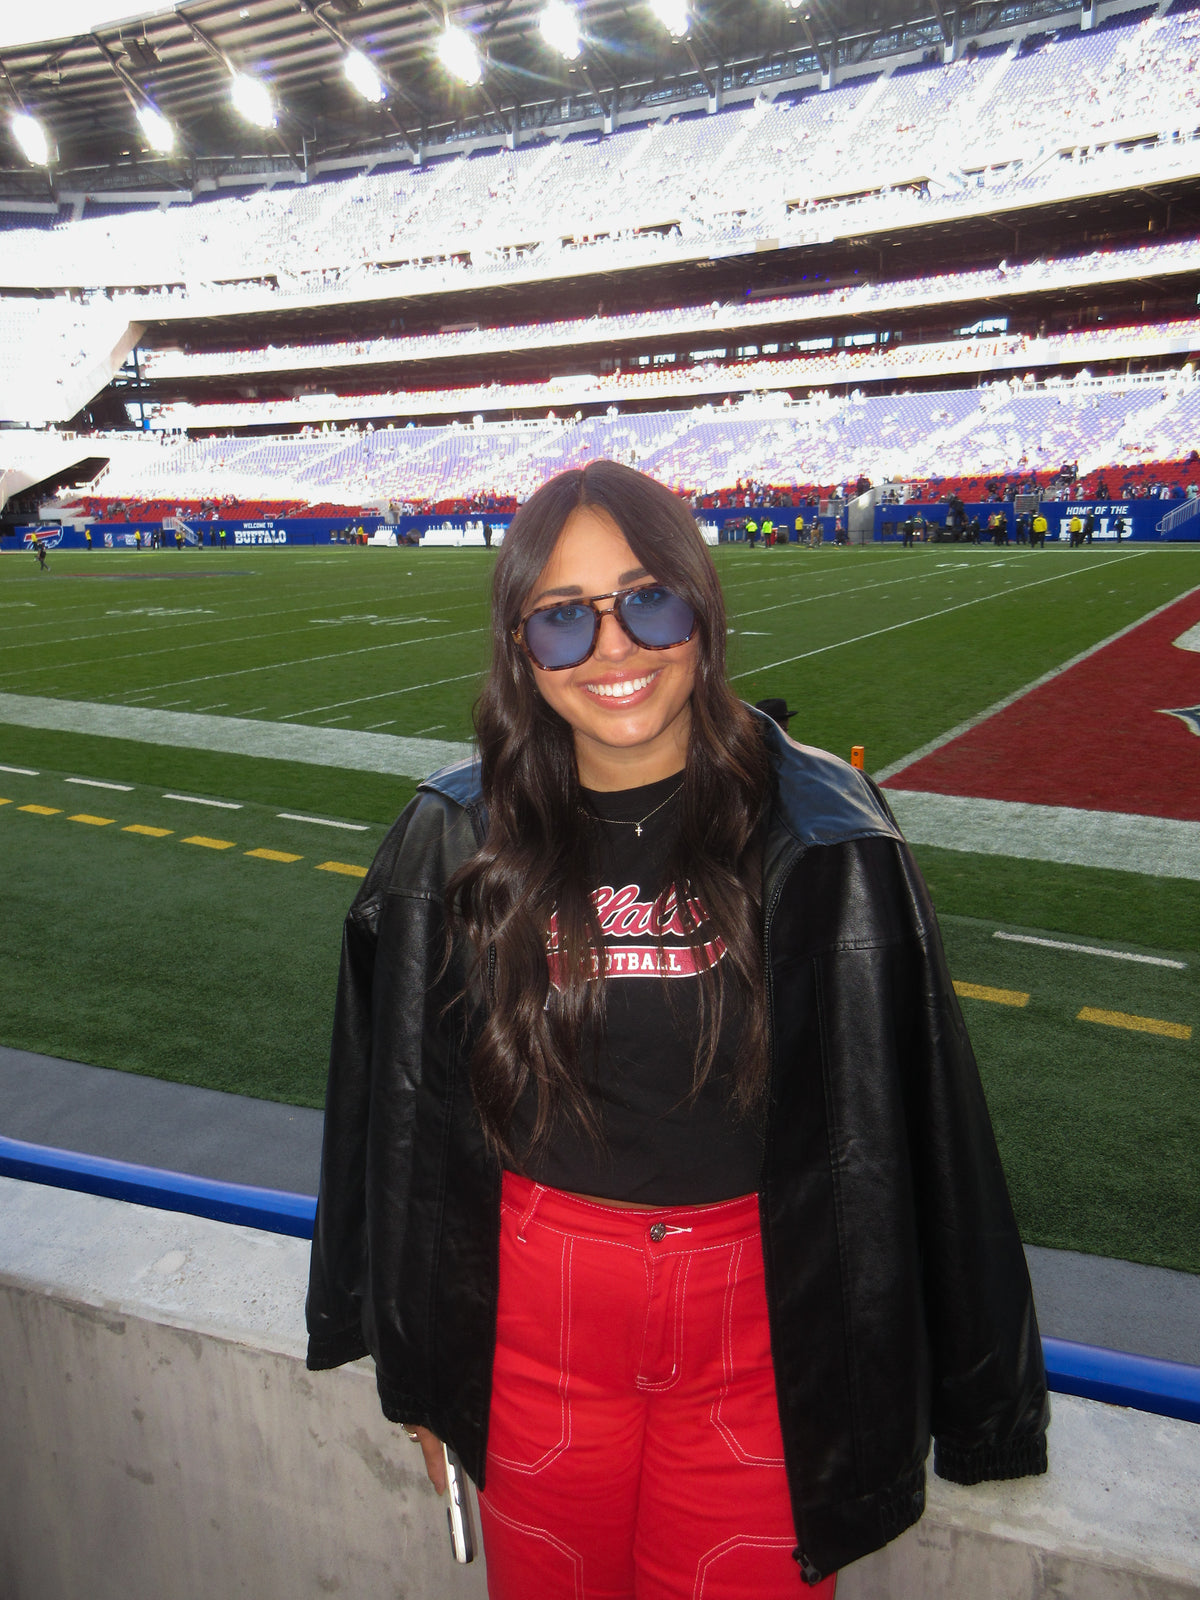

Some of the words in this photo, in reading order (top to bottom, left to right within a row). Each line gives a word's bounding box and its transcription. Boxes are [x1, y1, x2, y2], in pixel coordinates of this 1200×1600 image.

[1094, 506, 1107, 515] OF
[1110, 505, 1129, 515] THE
[234, 530, 287, 544] BUFFALO
[583, 952, 682, 972] TBALL
